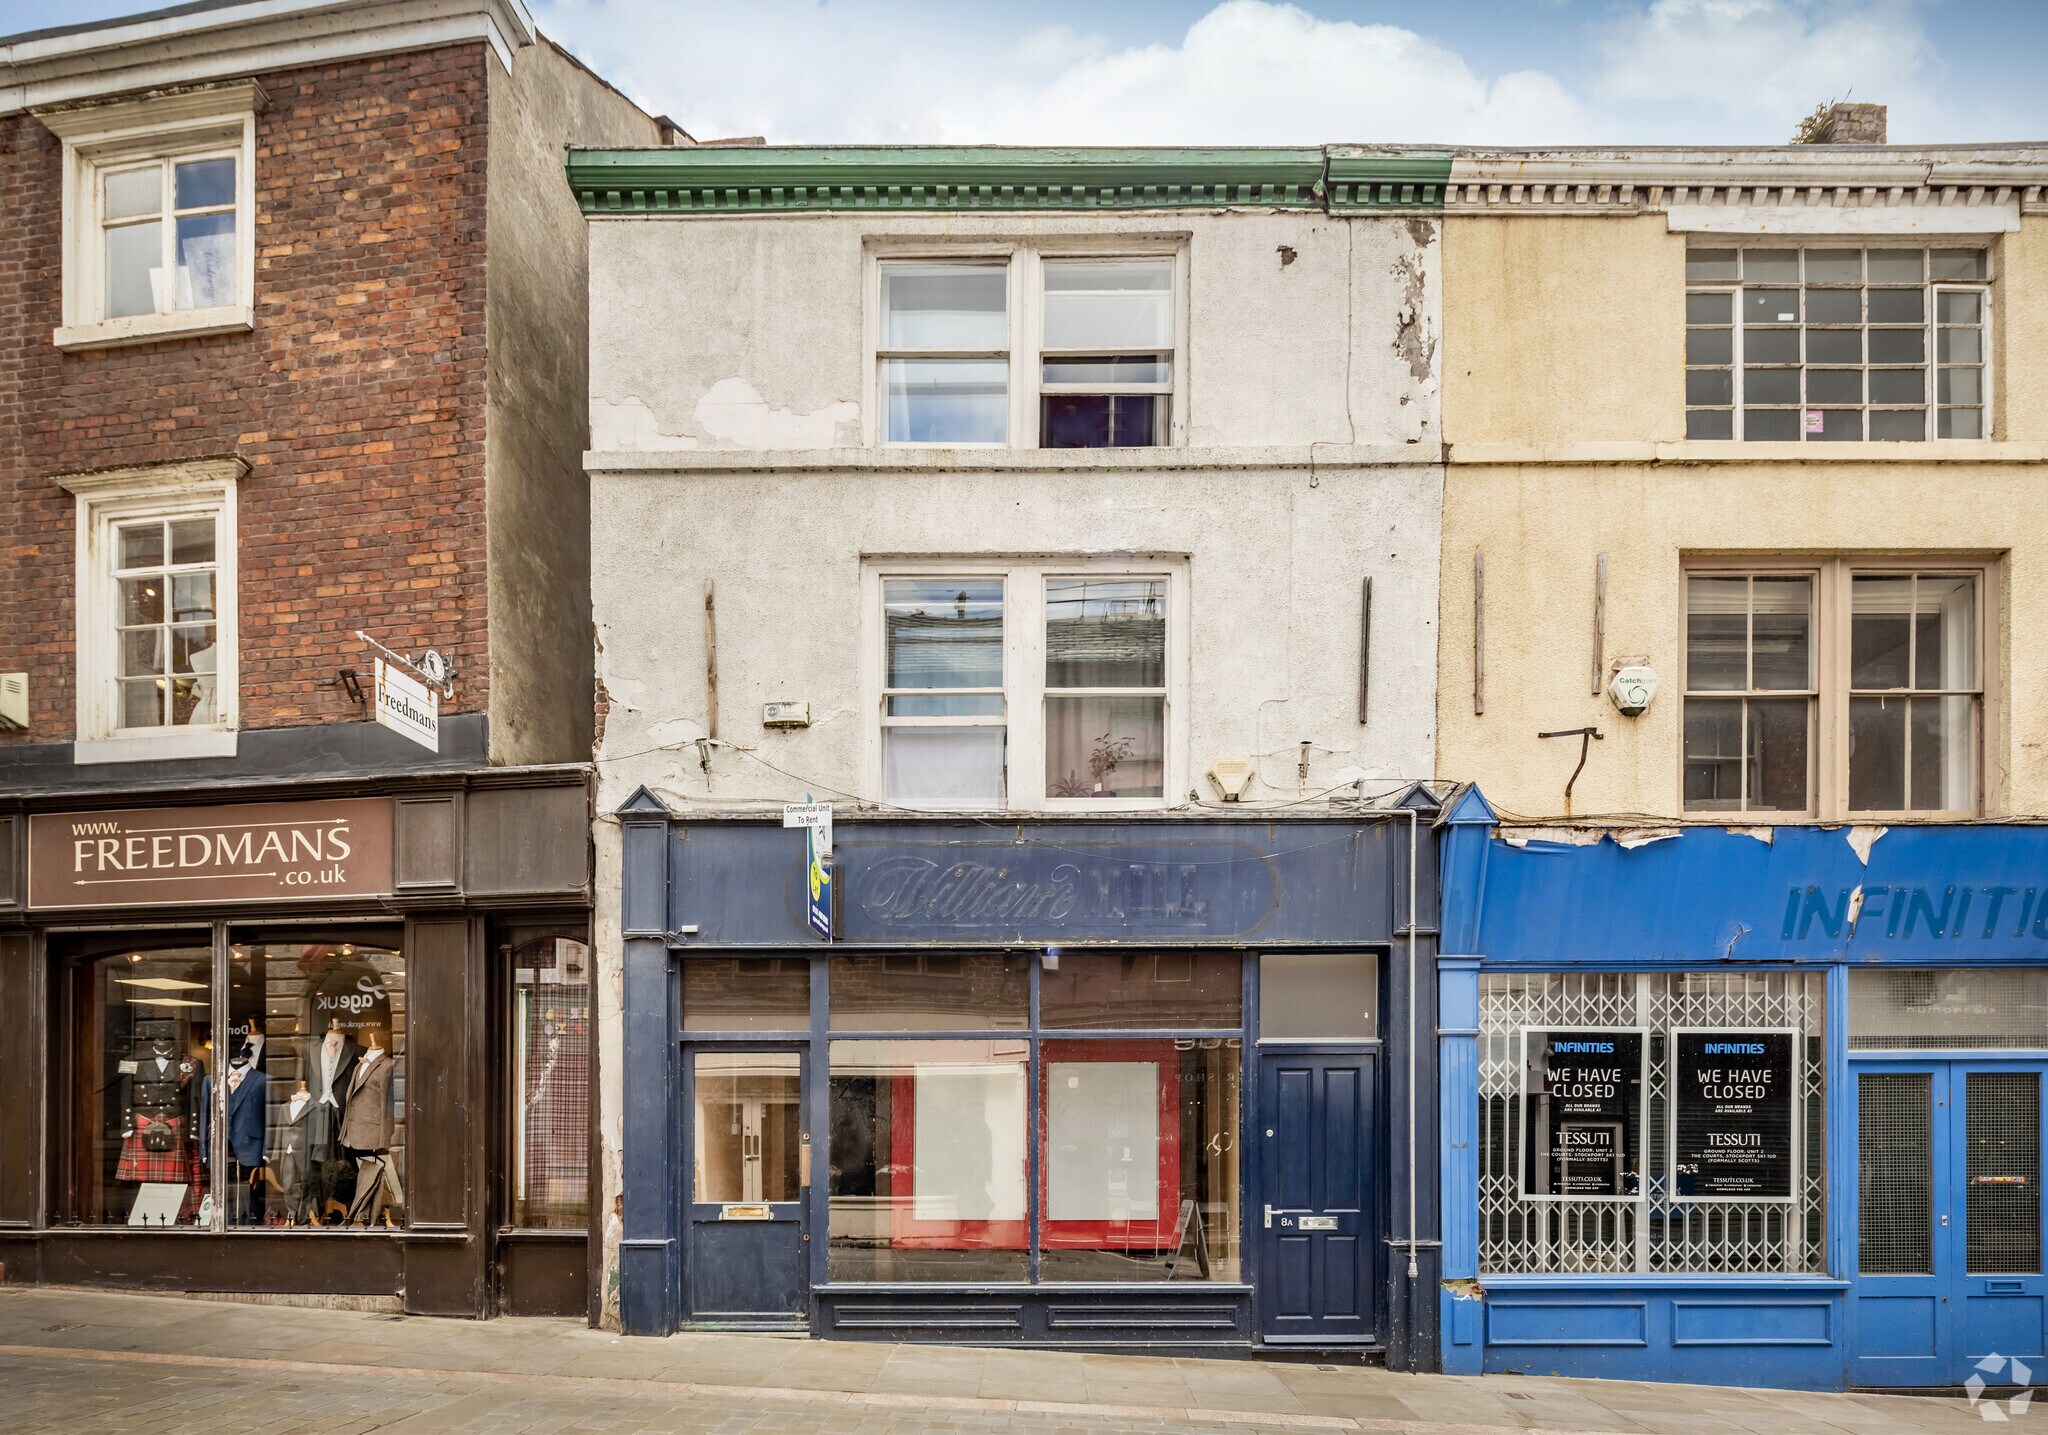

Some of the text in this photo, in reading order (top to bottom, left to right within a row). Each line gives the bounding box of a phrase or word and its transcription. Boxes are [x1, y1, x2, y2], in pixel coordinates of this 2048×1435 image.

[378, 681, 436, 732] Freedmans
[786, 803, 830, 813] Commercial Unit
[806, 816, 818, 824] Rent
[72, 822, 121, 836] www.
[74, 827, 351, 872] FREEDMANS
[279, 864, 346, 885] .co.uk
[1554, 1042, 1614, 1053] INFINITIES
[1705, 1043, 1765, 1054] INFINITIES
[1547, 1068, 1621, 1082] WE HAVE
[1697, 1069, 1772, 1083] WE HAVE
[1553, 1084, 1615, 1097] CLOSED
[1703, 1085, 1766, 1099] CLOSED
[1556, 1132, 1609, 1145] TESSUTI
[1707, 1133, 1761, 1146] TESSUTI
[1281, 1217, 1293, 1227] 8A
